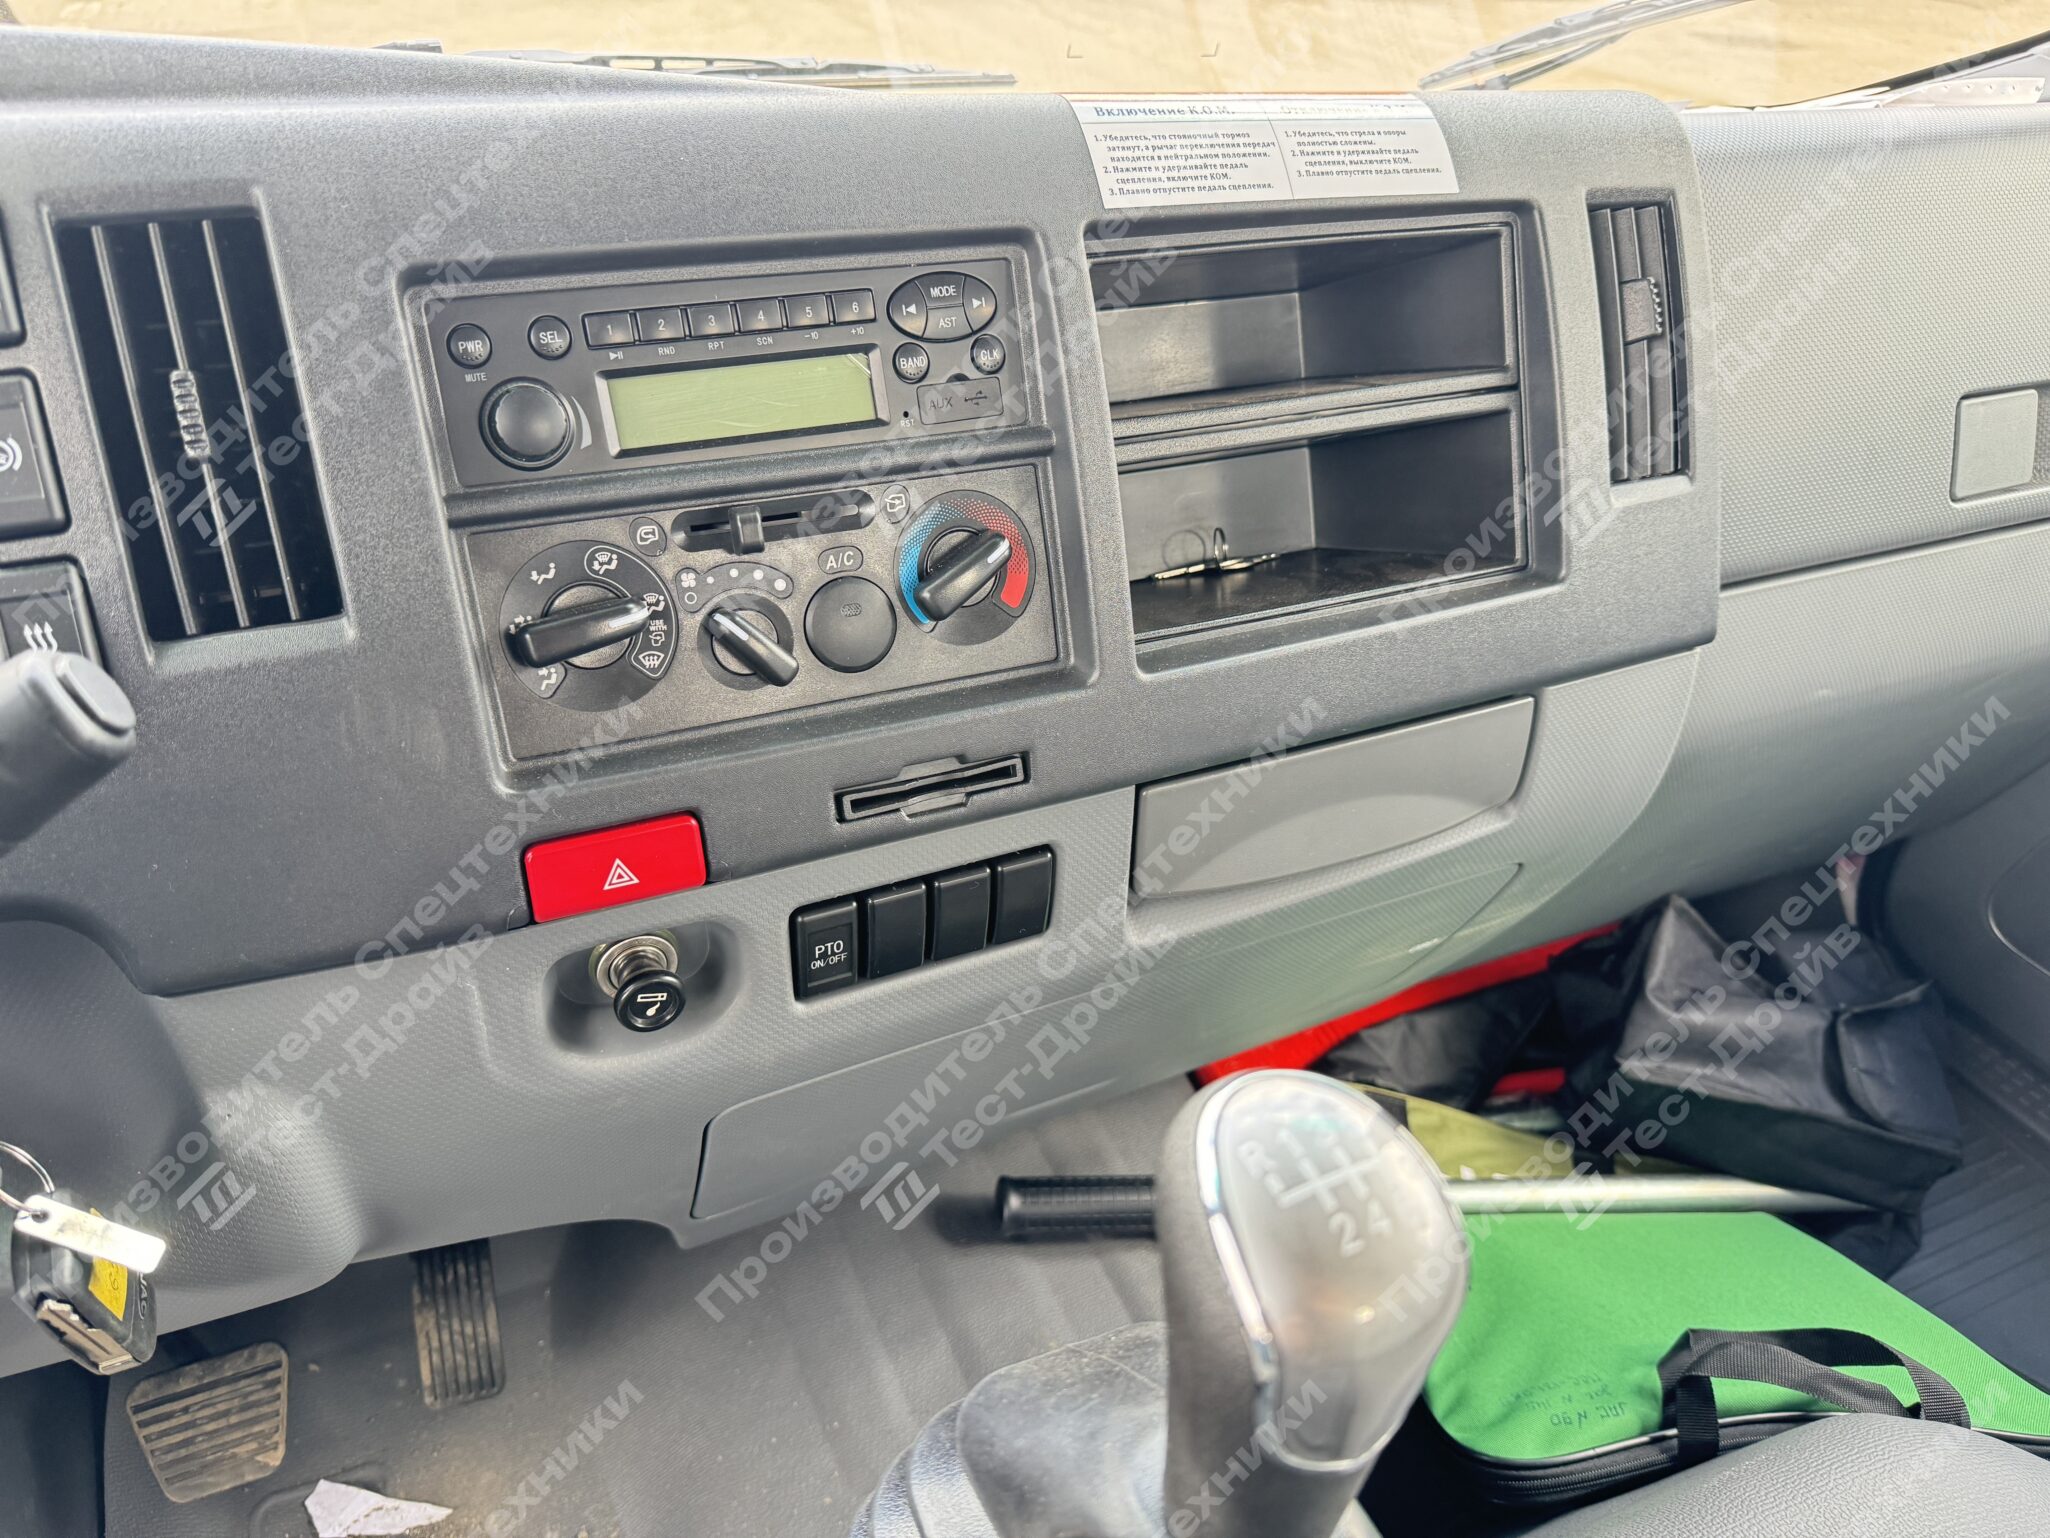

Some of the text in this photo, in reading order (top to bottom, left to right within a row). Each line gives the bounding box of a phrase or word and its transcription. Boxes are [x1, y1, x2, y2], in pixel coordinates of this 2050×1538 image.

[1094, 105, 1185, 117] Включение
[930, 284, 956, 297] MODE
[606, 302, 858, 336] 1 2 3 4 5 6
[938, 318, 956, 328] AST
[540, 331, 562, 344] SEL
[658, 346, 675, 356] RND
[708, 342, 724, 350] RPT
[756, 336, 773, 345] SCN
[850, 326, 864, 336] +10
[458, 340, 483, 353] PWR
[980, 349, 999, 361] CLK
[900, 356, 925, 369] BAND
[466, 372, 486, 382] MUTE
[928, 396, 952, 409] AUX
[900, 419, 915, 428] RST
[826, 552, 854, 569] A/C
[814, 940, 844, 959] PTO
[810, 950, 848, 968] ON/OFF
[1238, 1141, 1277, 1180] R
[1329, 1197, 1394, 1257] 2 4
